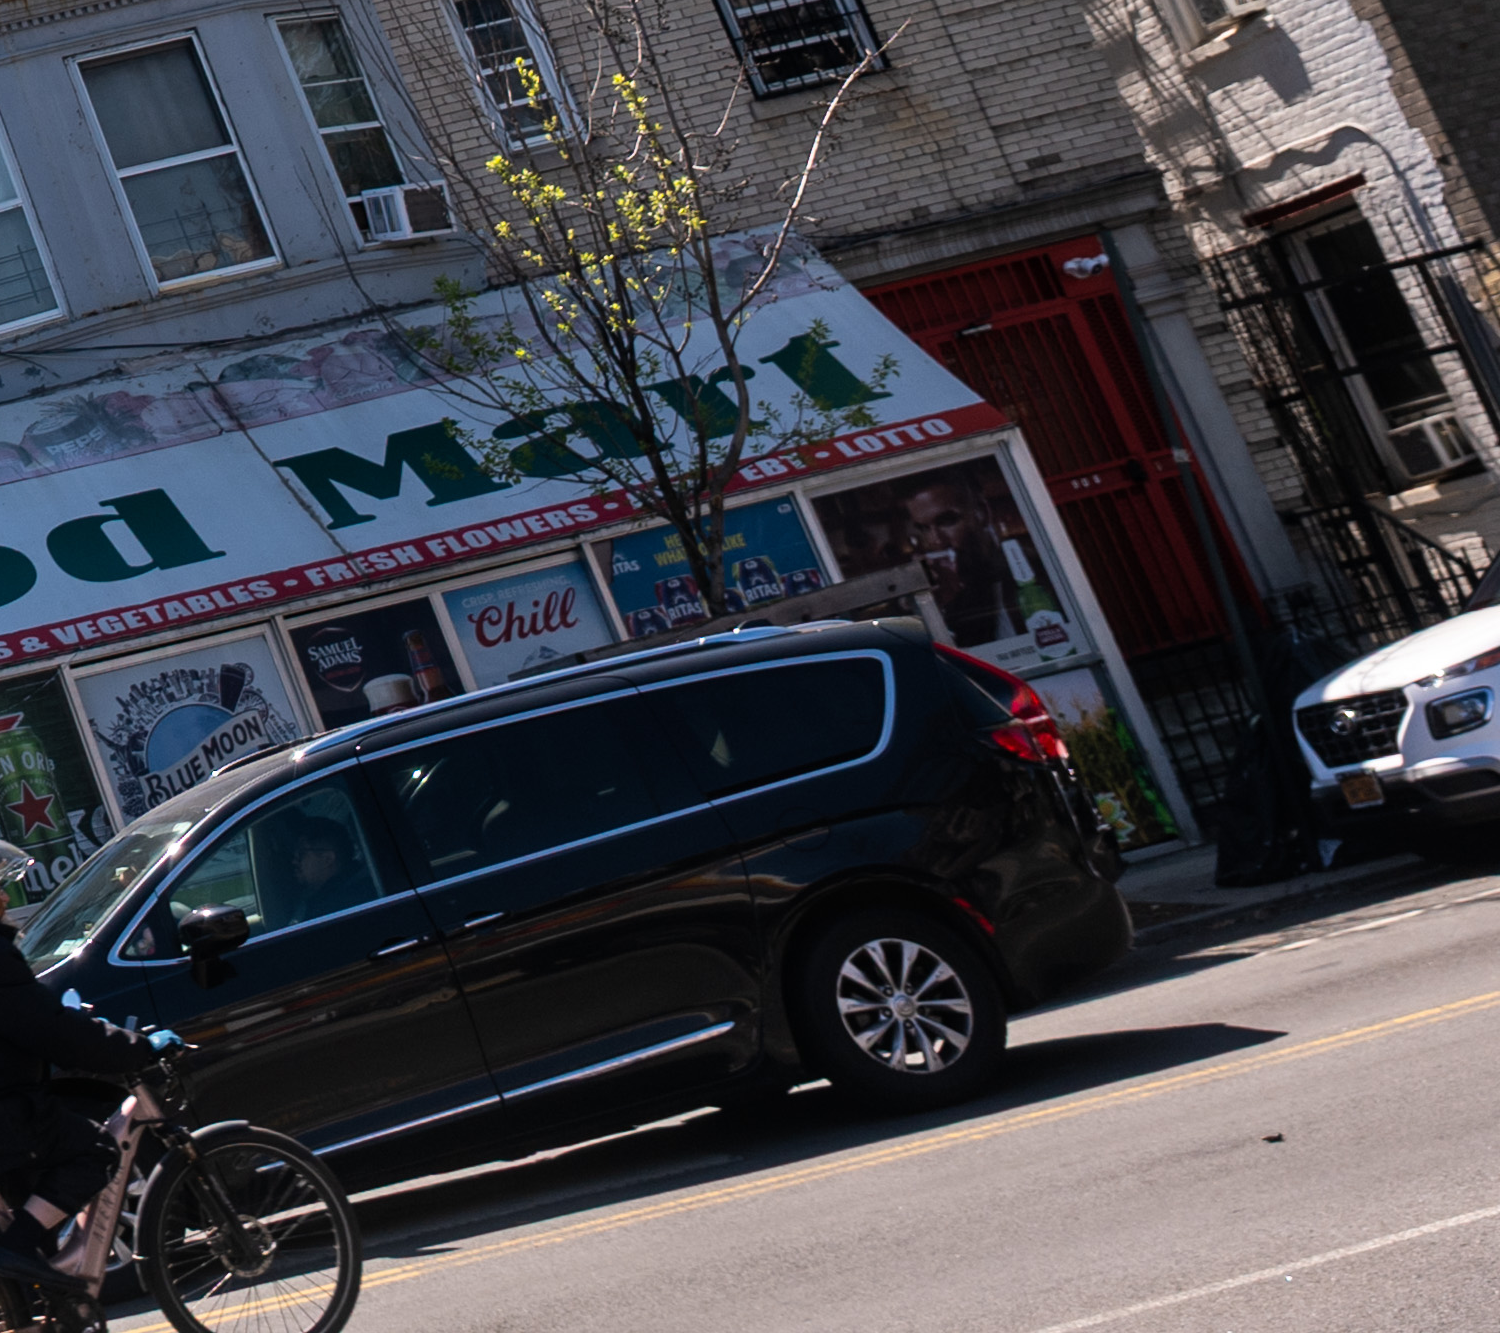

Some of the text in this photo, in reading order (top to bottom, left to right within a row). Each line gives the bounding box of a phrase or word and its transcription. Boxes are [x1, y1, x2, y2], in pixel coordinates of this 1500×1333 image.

[272, 333, 894, 530] Mart
[19, 635, 49, 654] &
[49, 580, 277, 647] VEGETABLES
[304, 543, 422, 588] FRESH
[424, 501, 599, 559] FLOWERS
[739, 451, 808, 482] EBT
[833, 417, 954, 460] LOTTO
[613, 558, 642, 577] ITAS
[467, 586, 579, 648] Chill
[307, 636, 364, 662] SAMUEL
[317, 649, 363, 673] ADAMS
[145, 761, 206, 807] BLUE
[202, 714, 266, 771] MOON
